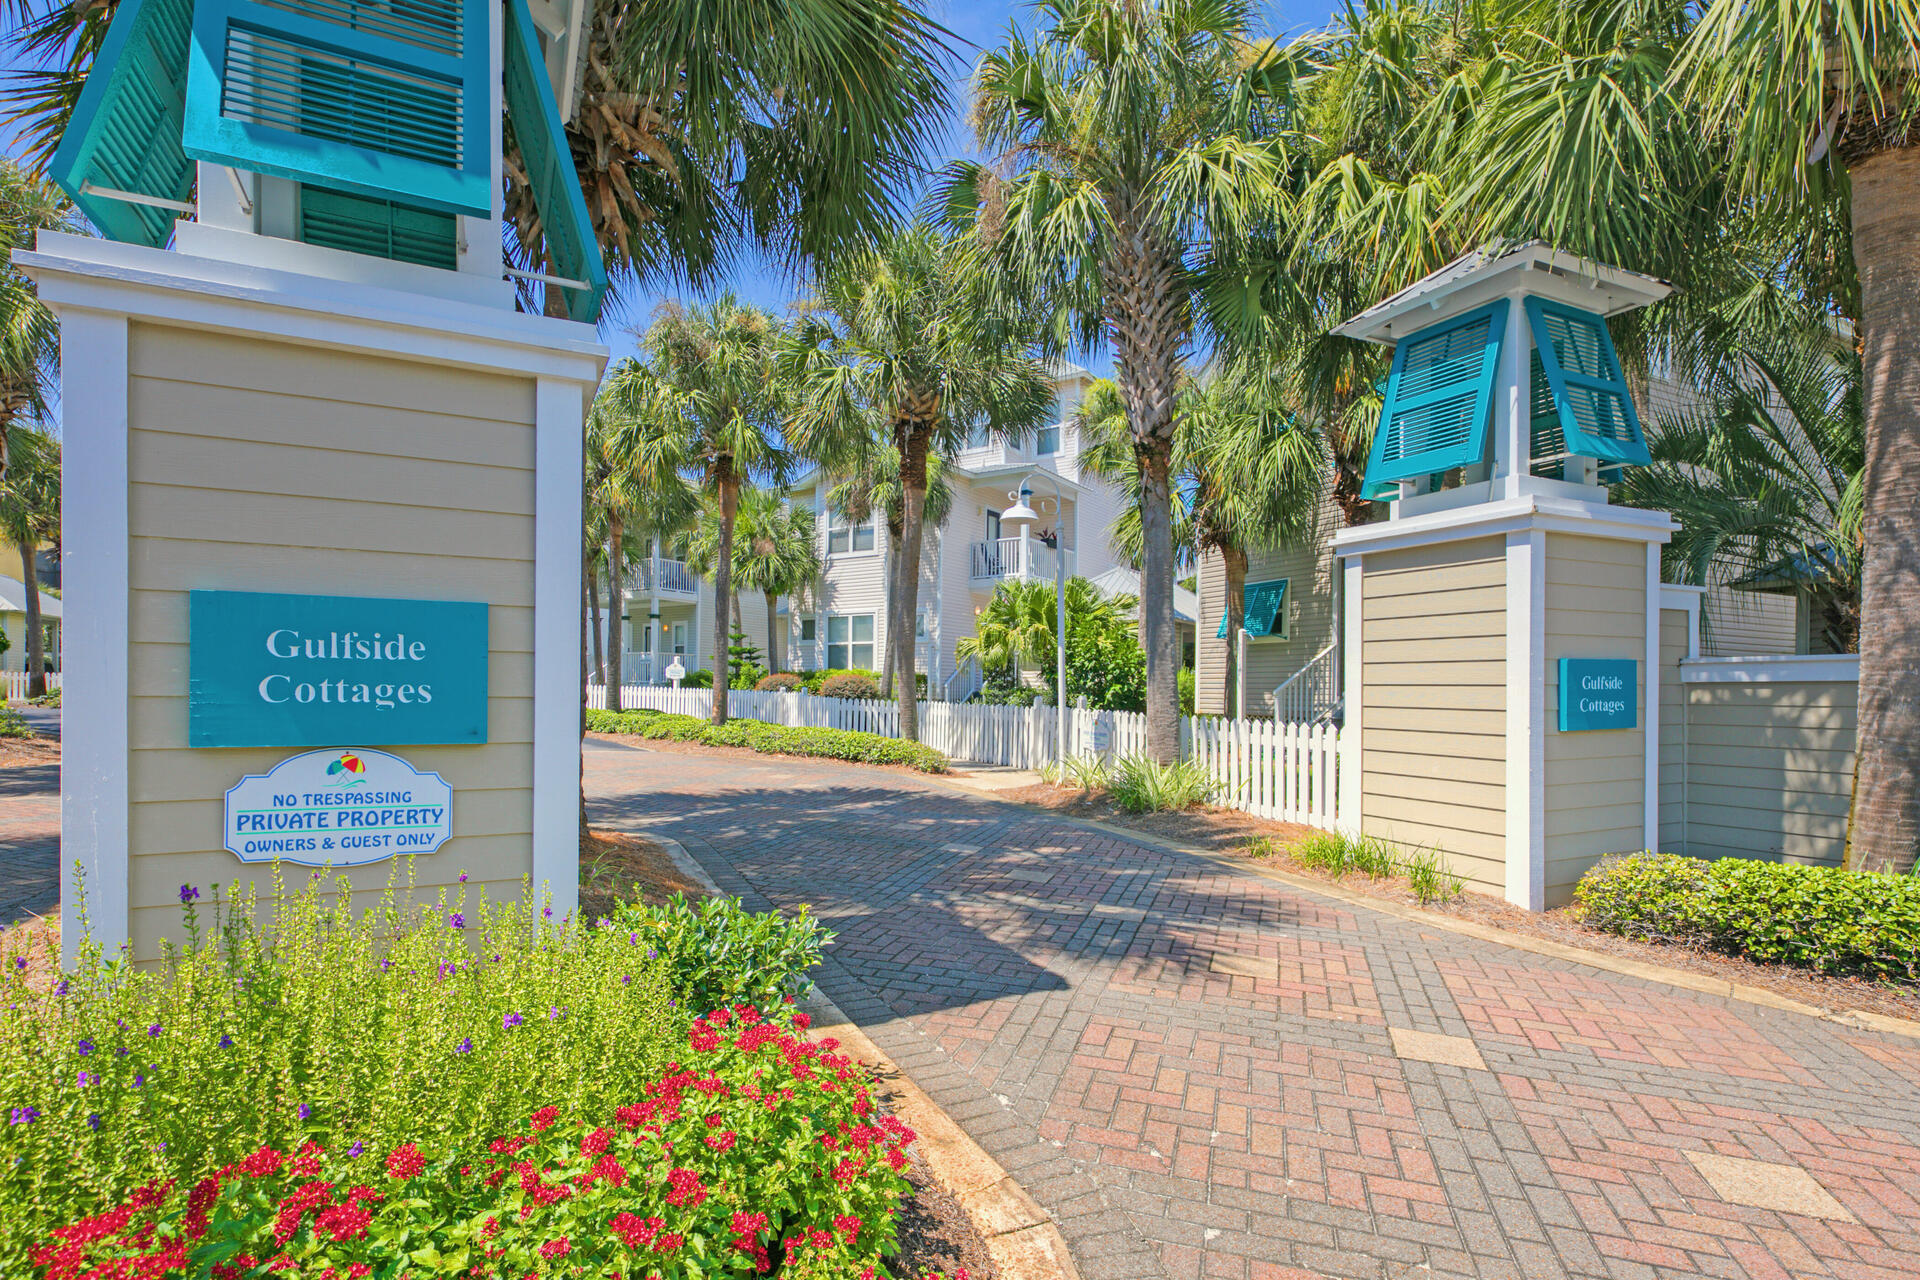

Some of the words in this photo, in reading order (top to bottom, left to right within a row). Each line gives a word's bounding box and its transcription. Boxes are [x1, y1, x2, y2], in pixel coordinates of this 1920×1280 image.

[266, 629, 426, 661] Gulfside
[258, 674, 432, 711] Cottages
[1582, 675, 1623, 690] Gulfside
[1580, 697, 1625, 715] Cottages
[273, 794, 297, 807] NO
[303, 791, 412, 806] TRESPASSING
[236, 811, 329, 831] PRIVATE
[337, 808, 444, 827] PROPERTY
[245, 838, 316, 853] OWNERS
[322, 837, 336, 849] &
[341, 834, 392, 848] GUEST
[396, 833, 435, 846] ONLY
